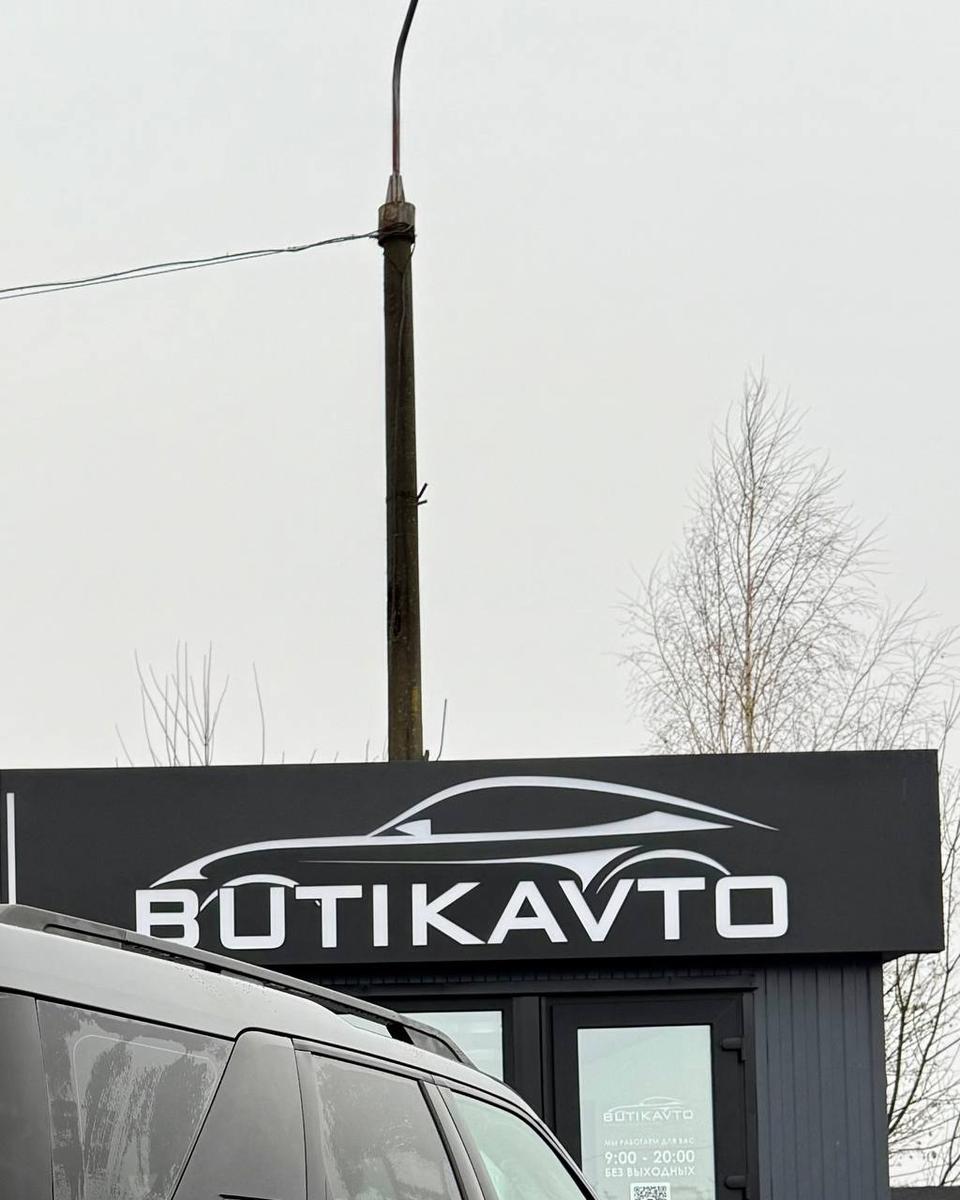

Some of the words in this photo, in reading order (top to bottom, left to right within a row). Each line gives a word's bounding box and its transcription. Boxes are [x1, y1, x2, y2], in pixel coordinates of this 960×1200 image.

[135, 874, 789, 950] BUTIKAVTO
[603, 1109, 694, 1122] BUTIKAVTO
[604, 1151, 637, 1165] 9:00
[653, 1149, 696, 1164] 20:00
[604, 1167, 624, 1178] БЕЗ
[626, 1165, 696, 1178] ВЫХОДНЫХ
